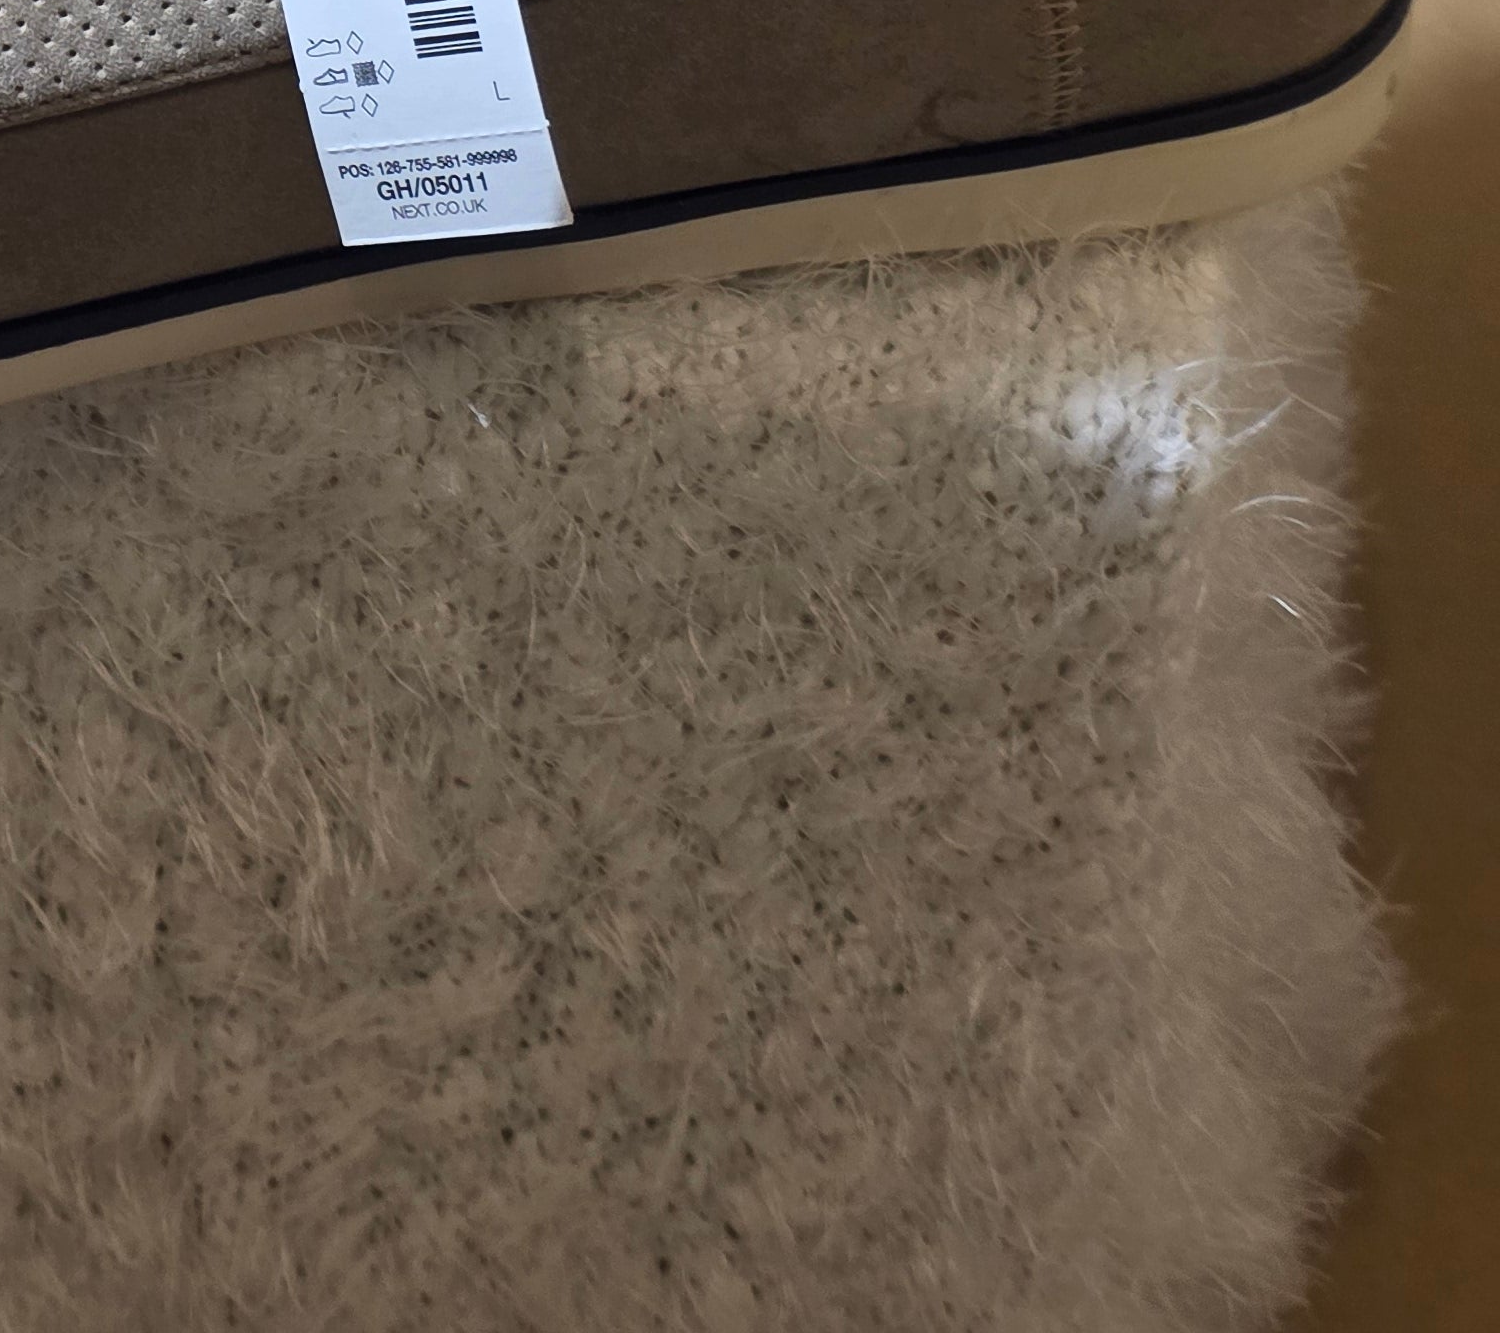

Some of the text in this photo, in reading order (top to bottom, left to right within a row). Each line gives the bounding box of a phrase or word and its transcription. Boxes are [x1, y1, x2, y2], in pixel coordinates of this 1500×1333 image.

[338, 165, 374, 179] POS:
[377, 172, 488, 201] GH/05011
[392, 198, 488, 220] NEXT.CO.UK
